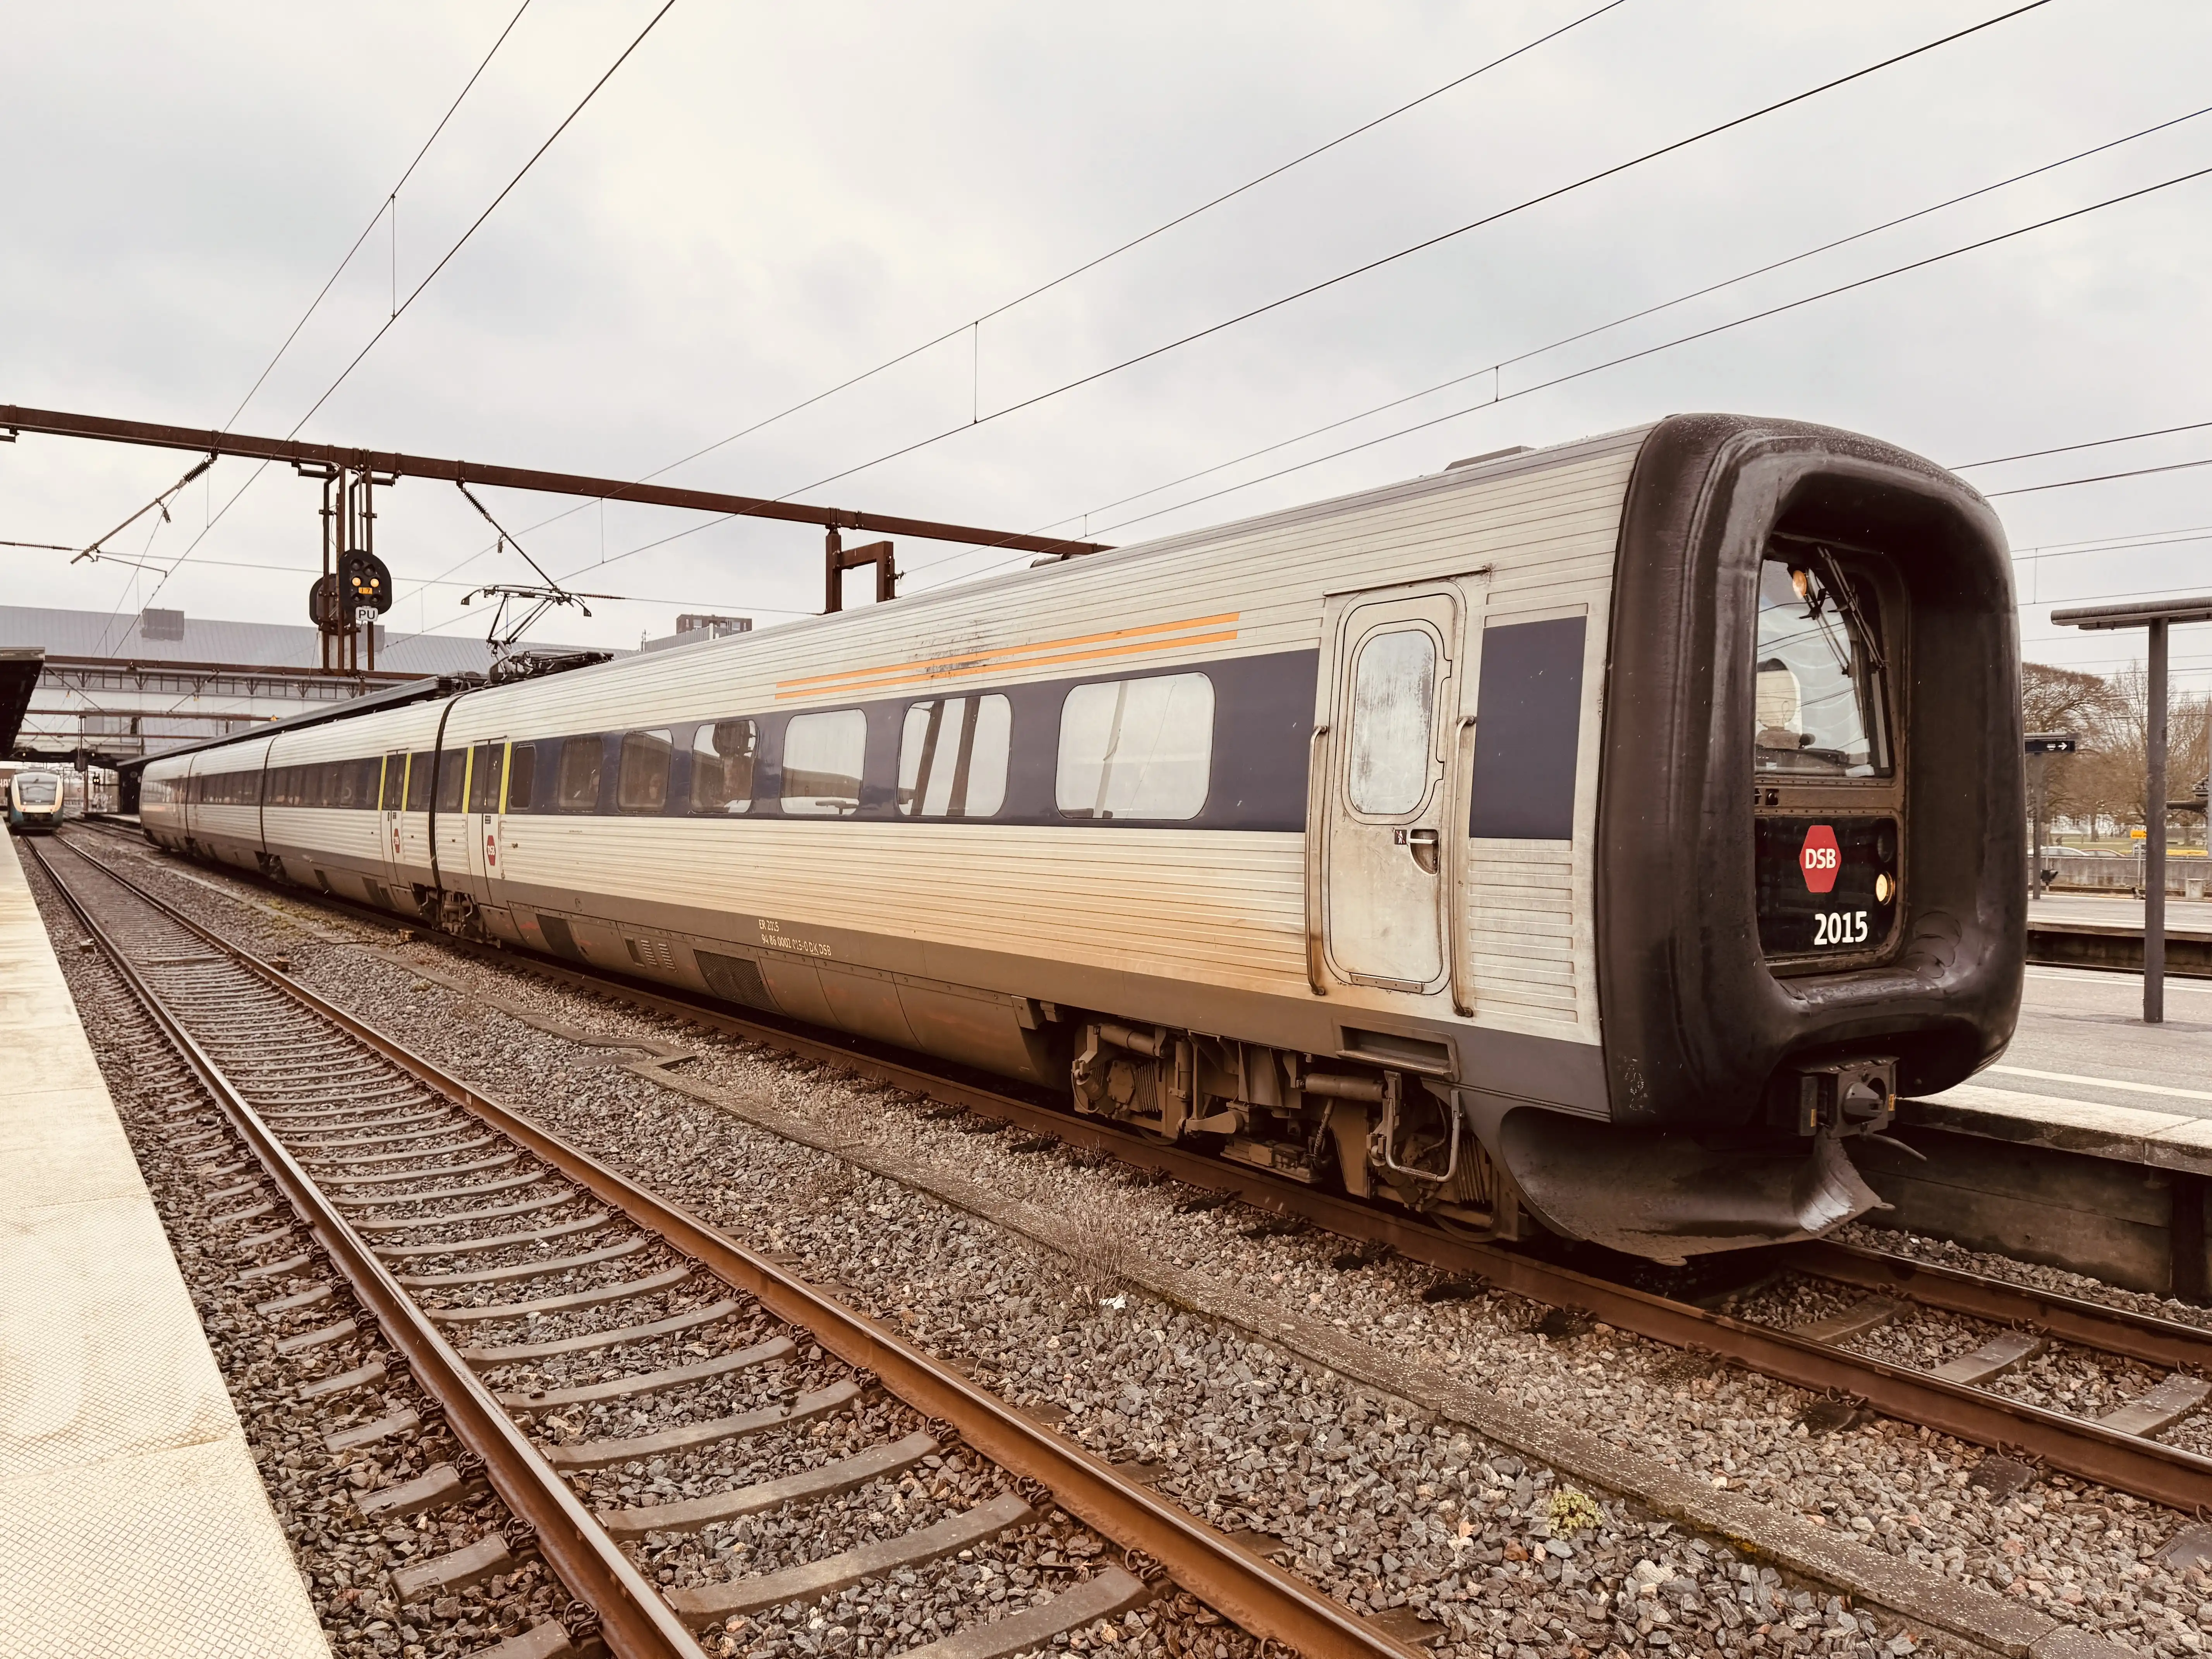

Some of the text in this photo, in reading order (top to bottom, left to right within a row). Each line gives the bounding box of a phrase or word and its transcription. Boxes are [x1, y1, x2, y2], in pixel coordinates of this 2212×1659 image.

[359, 610, 375, 619] PU
[1805, 848, 1836, 869] DSB
[759, 919, 779, 932] ER 2015
[1814, 911, 1868, 945] 2015
[761, 934, 769, 945] 94
[769, 935, 776, 946] 86
[777, 936, 792, 948] 0002
[809, 942, 819, 954] DK
[818, 944, 831, 956] DSB
